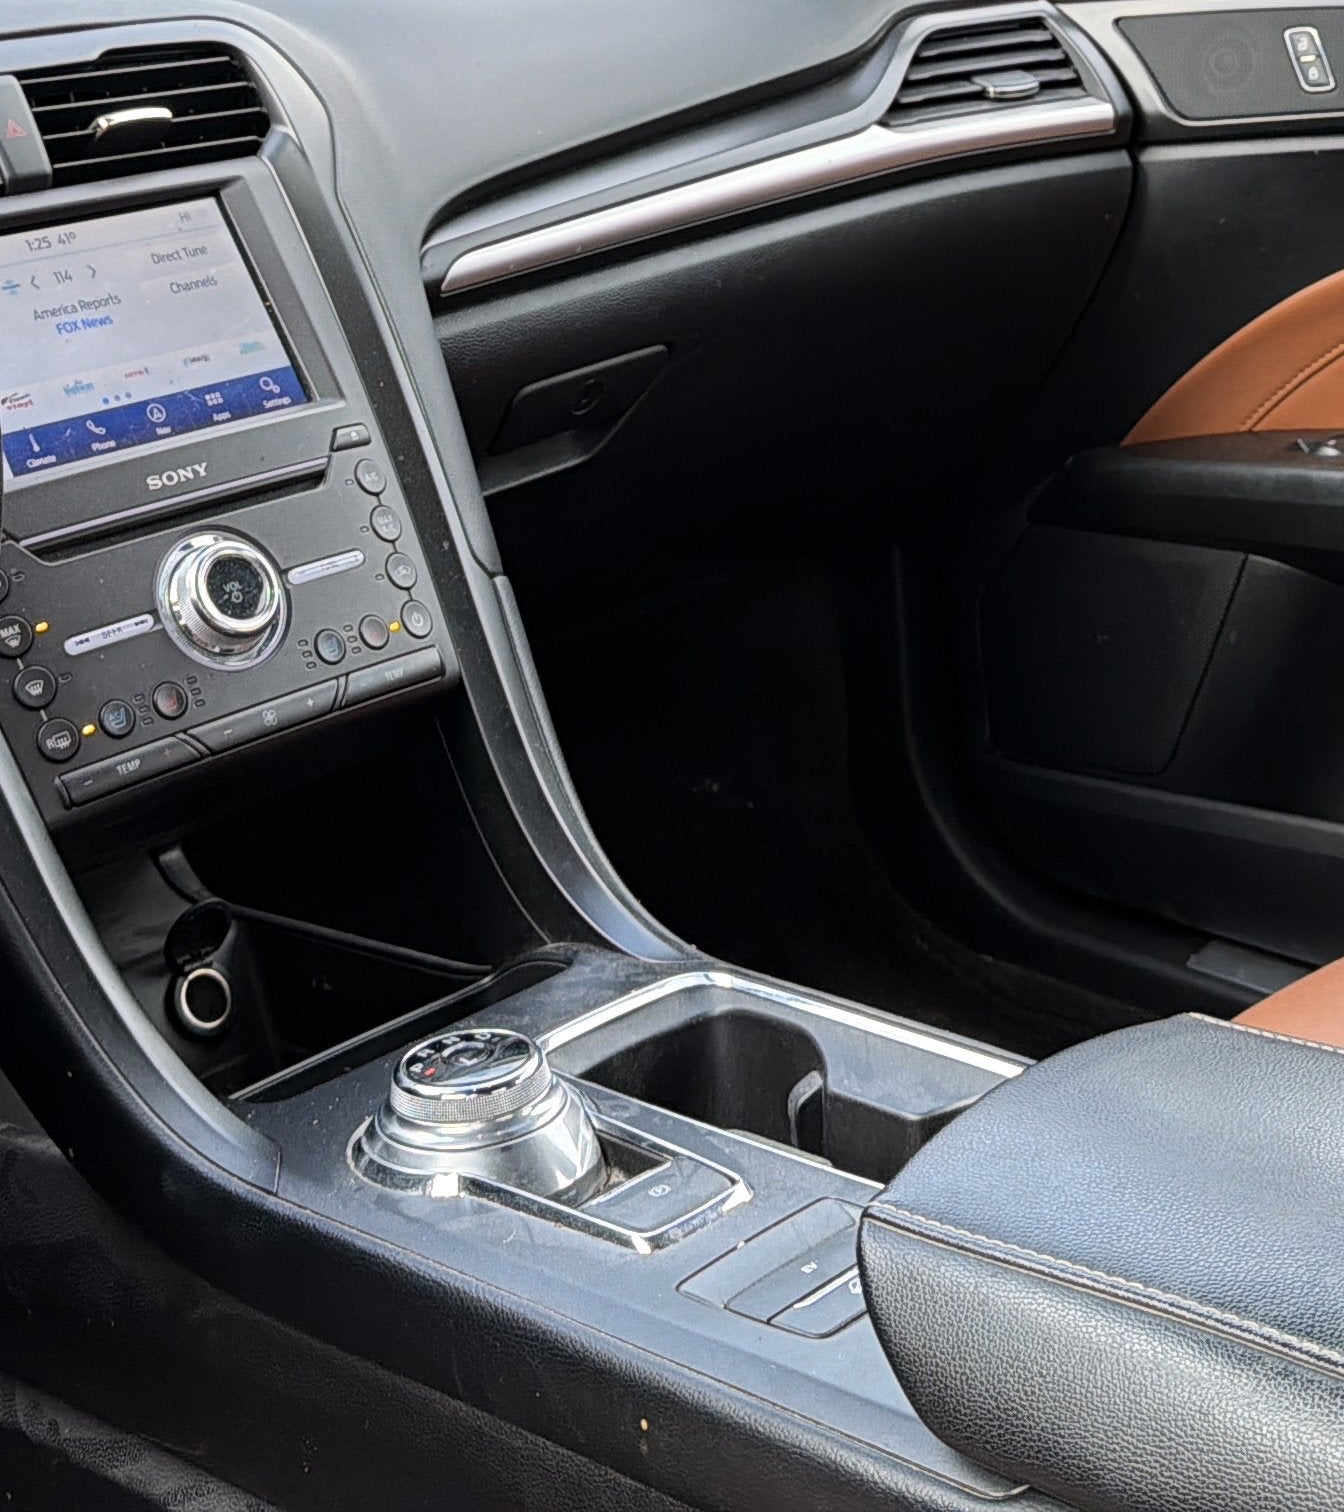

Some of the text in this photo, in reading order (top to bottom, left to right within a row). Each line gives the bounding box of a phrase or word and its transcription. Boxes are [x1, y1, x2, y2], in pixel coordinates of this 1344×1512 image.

[25, 236, 52, 253] 1:25
[151, 244, 208, 266] Direct Tune
[54, 270, 73, 285] 114
[170, 275, 218, 295] Channels
[33, 292, 122, 321] America Reports
[56, 313, 113, 335] FOX News
[91, 438, 116, 452] Phone
[263, 395, 291, 409] Settings
[146, 462, 208, 491] SONY
[223, 580, 243, 592] VOL
[0, 625, 21, 638] MAX
[116, 759, 141, 776] TEMP
[409, 1063, 424, 1073] P
